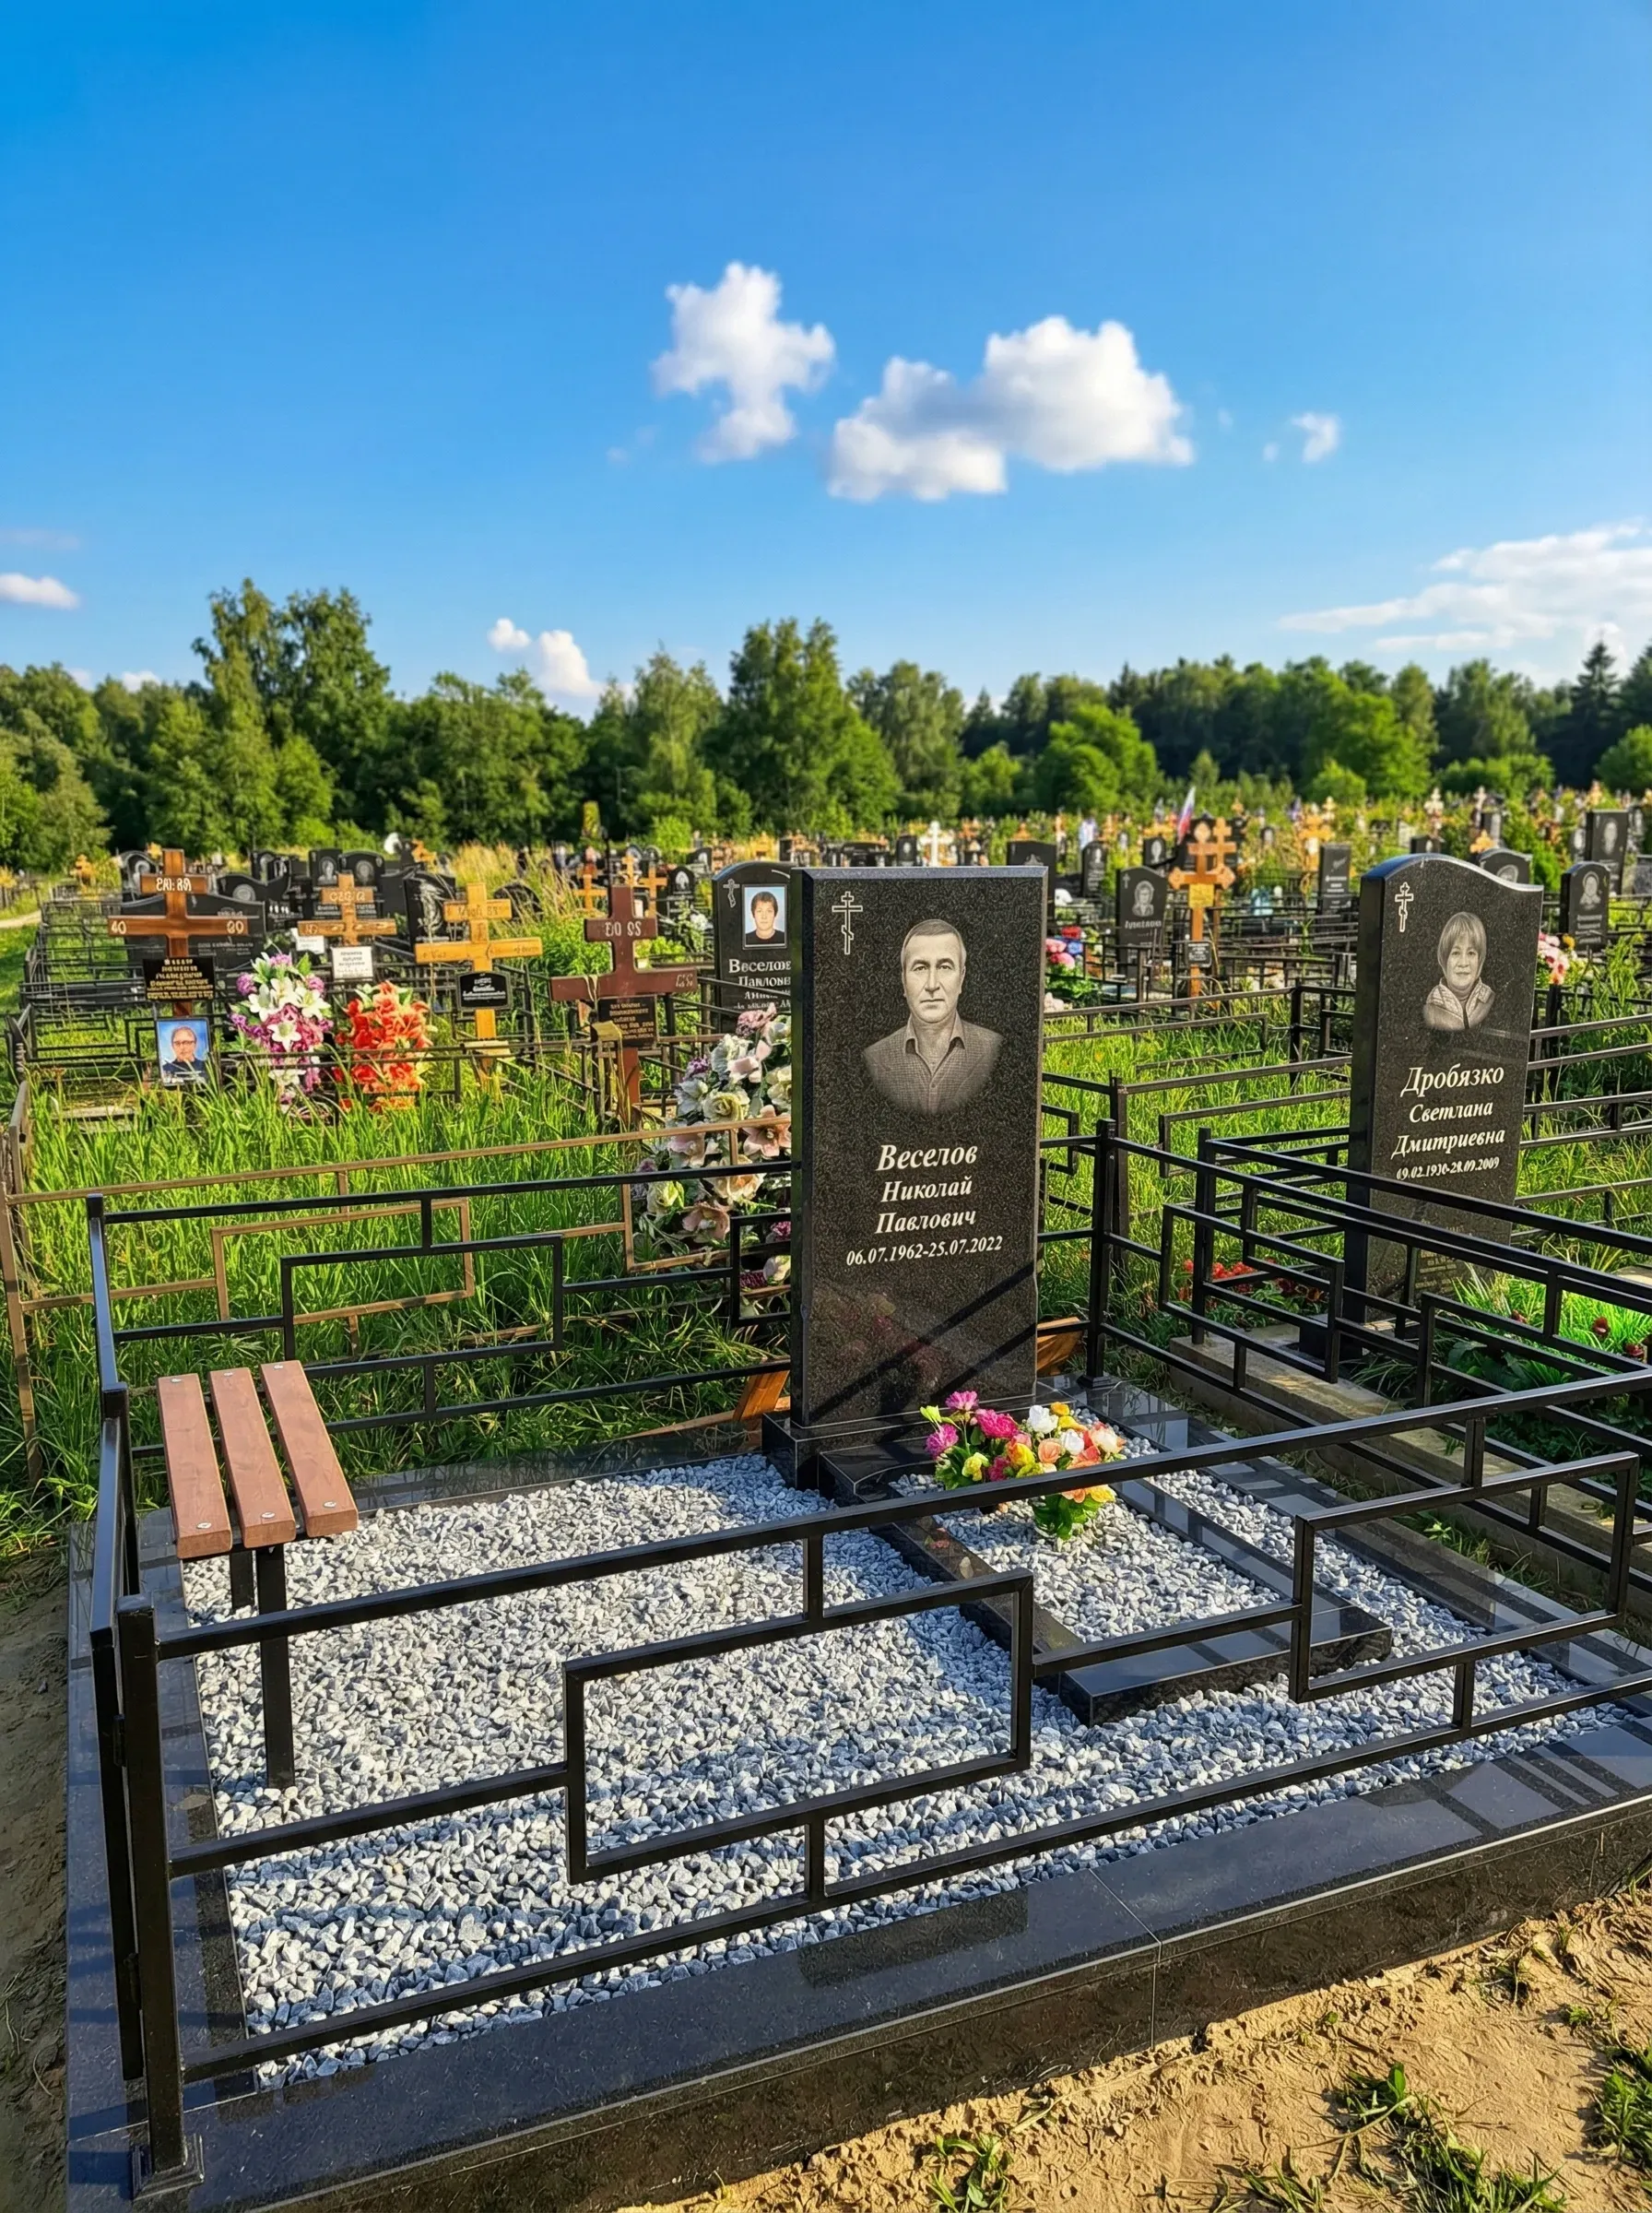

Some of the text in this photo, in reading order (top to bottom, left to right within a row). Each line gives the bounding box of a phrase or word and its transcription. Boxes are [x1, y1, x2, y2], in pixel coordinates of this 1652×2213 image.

[1399, 1062, 1504, 1097] Дробязко
[1409, 1102, 1493, 1123] Светлана
[875, 1144, 978, 1172] Веселов
[1390, 1130, 1505, 1160] Дмитриевна
[880, 1176, 973, 1202] Николай
[875, 1210, 977, 1235] Павлович
[846, 1236, 1003, 1266] 06.07.1962-25.07.2022
